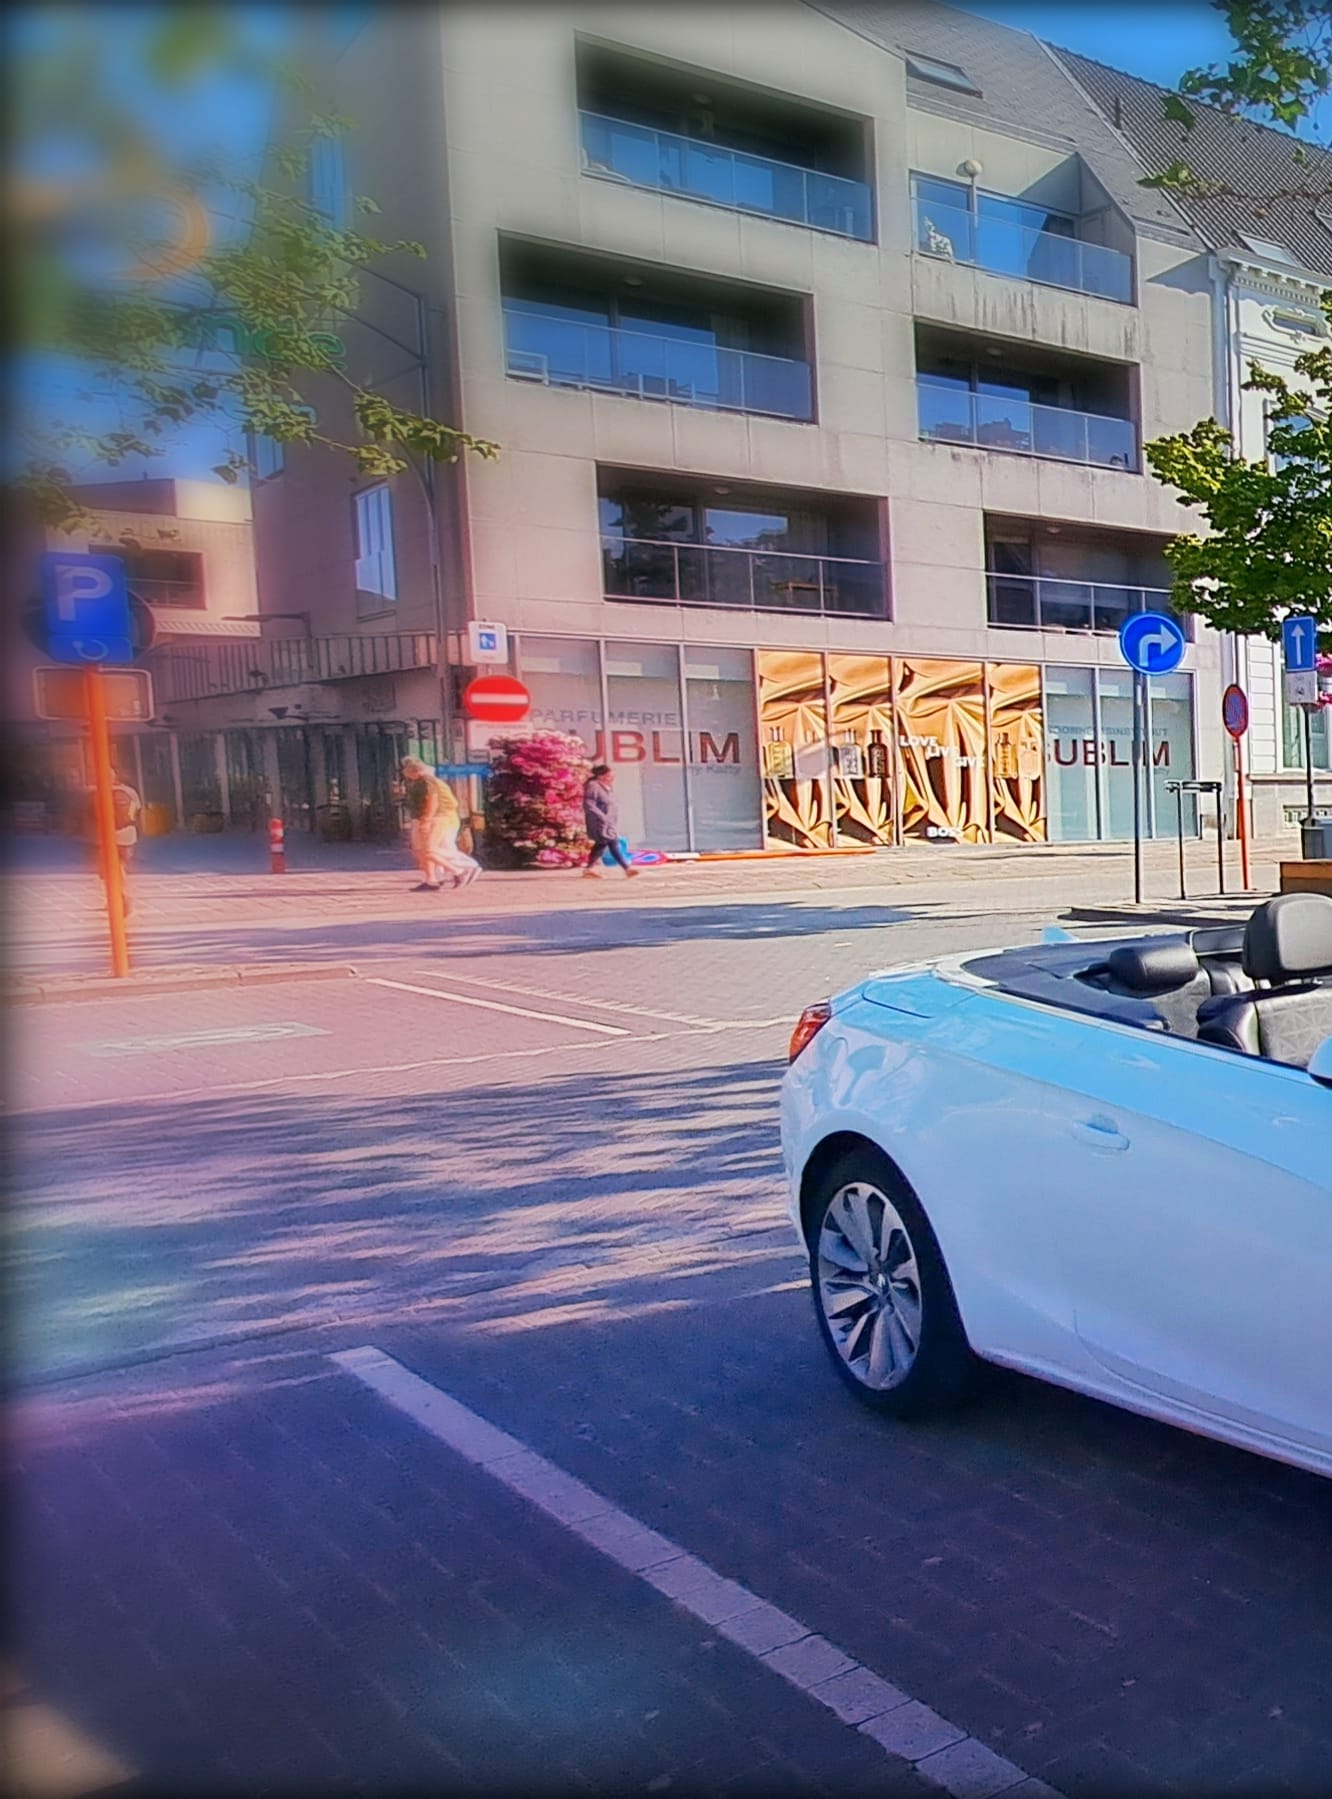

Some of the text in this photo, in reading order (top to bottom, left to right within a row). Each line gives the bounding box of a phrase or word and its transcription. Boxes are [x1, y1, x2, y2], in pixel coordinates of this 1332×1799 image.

[55, 564, 113, 622] P
[530, 708, 678, 726] PARFUMERIE
[566, 729, 741, 764] UBLIM
[899, 735, 938, 747] LOVE
[1047, 738, 1170, 767] UBLIM
